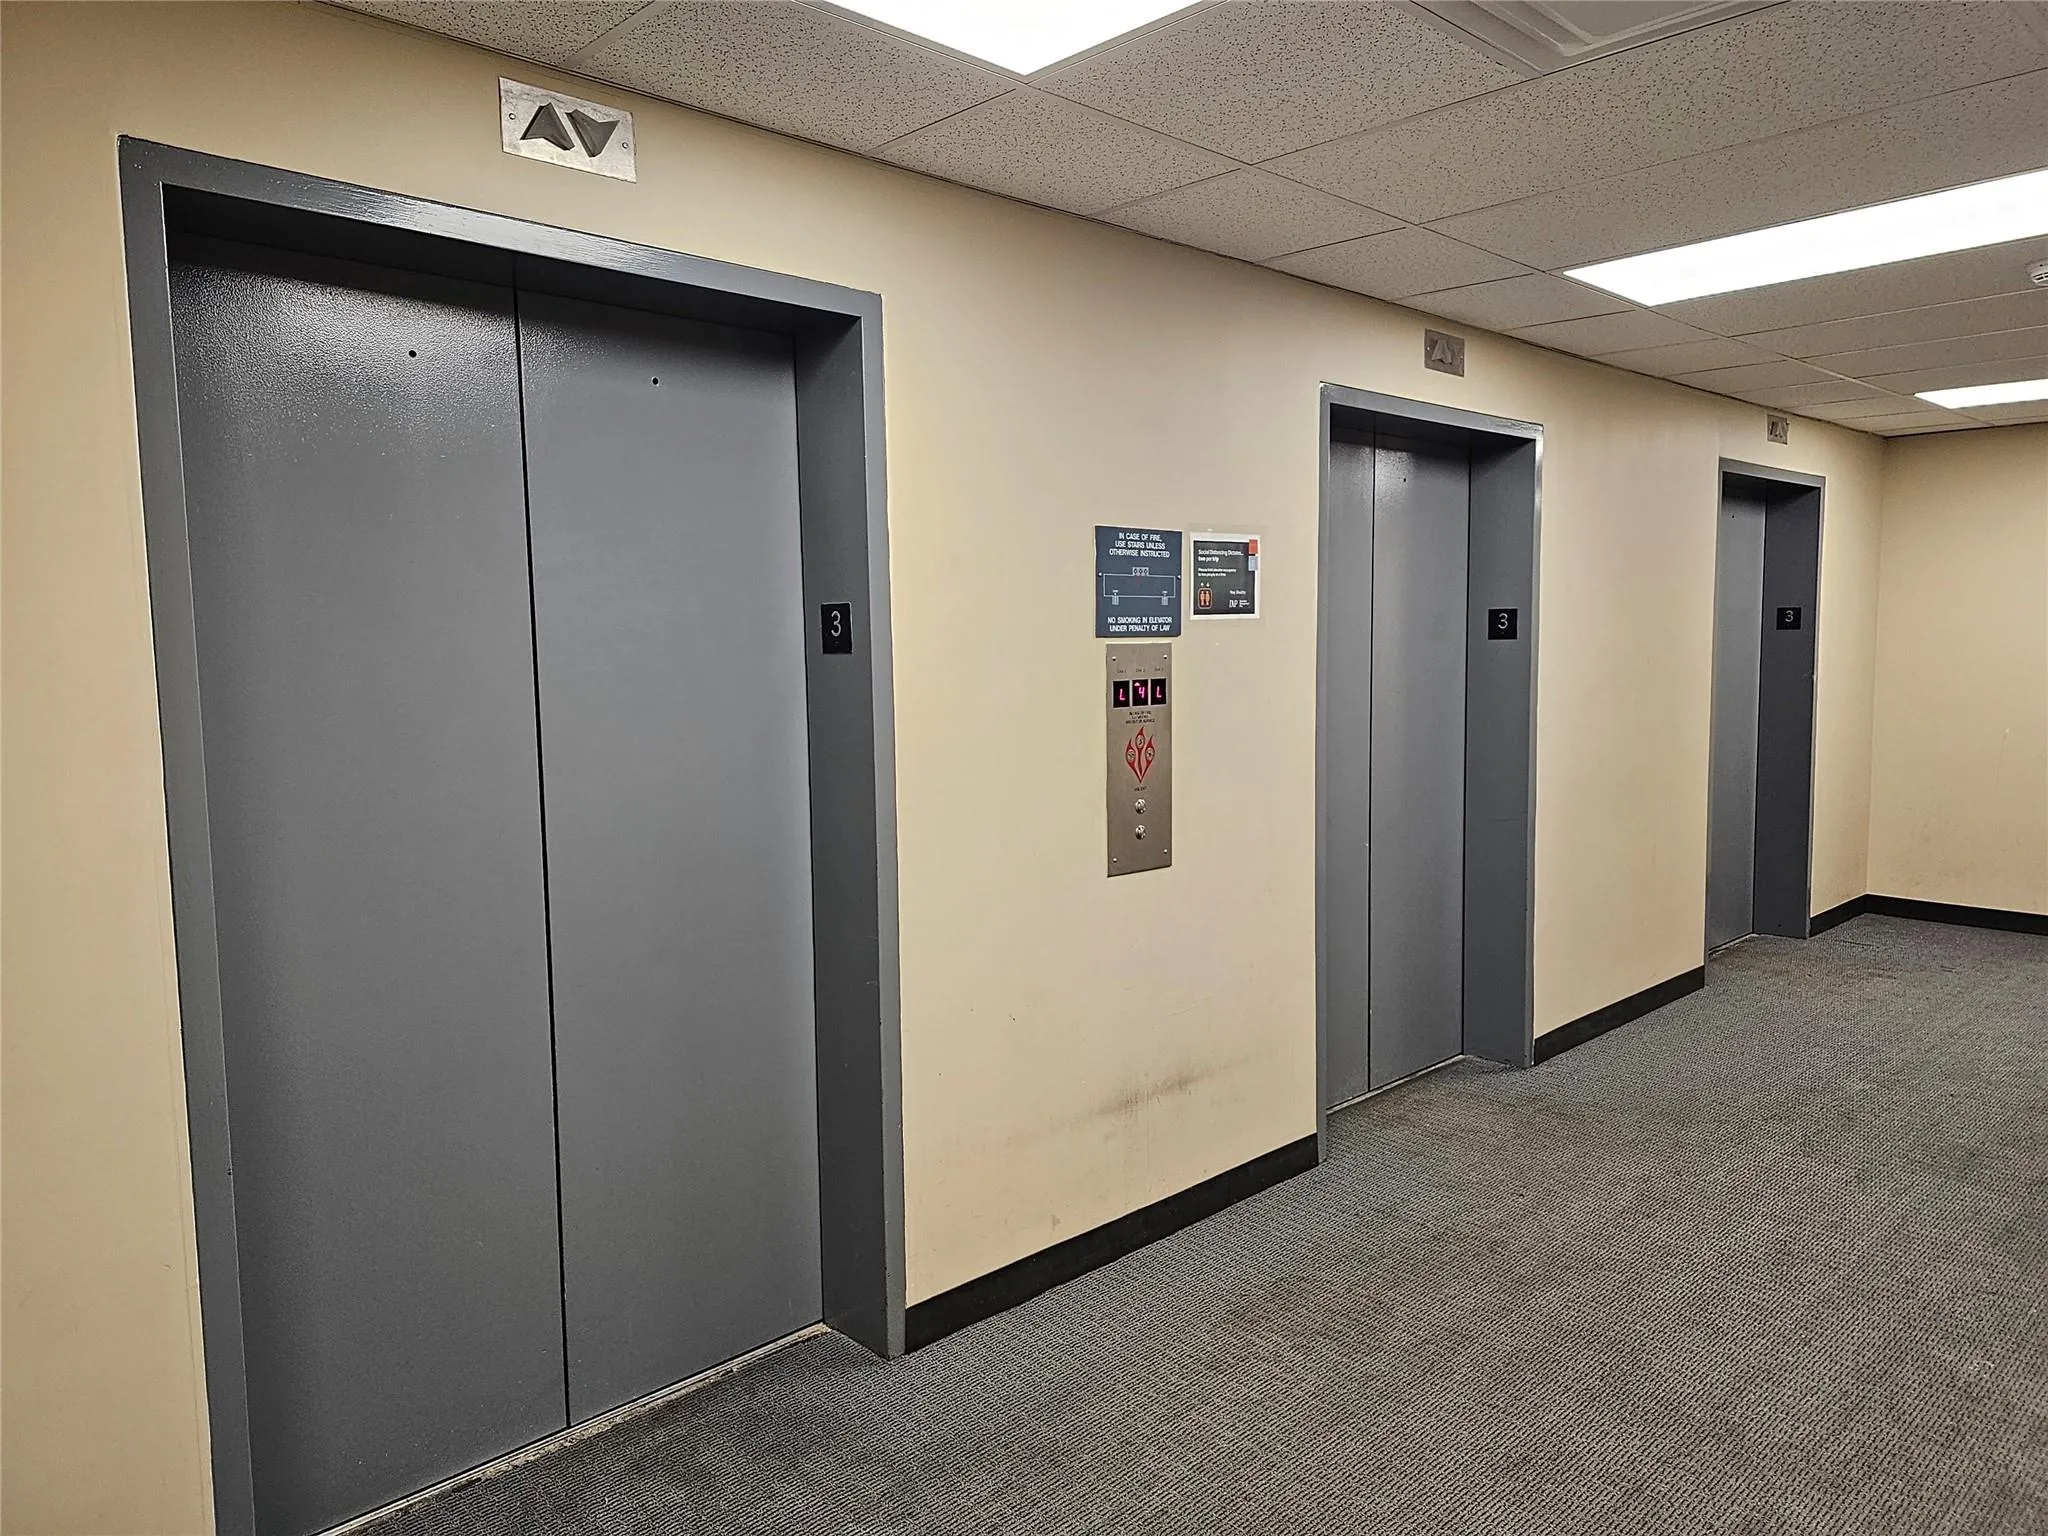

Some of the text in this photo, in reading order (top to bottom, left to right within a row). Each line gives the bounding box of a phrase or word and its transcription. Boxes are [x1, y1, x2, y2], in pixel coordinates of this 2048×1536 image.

[1141, 533, 1149, 541] OF
[1115, 540, 1126, 548] USE
[1127, 541, 1145, 549] STAIRS
[1109, 548, 1170, 558] OTHERWISE INSTRUCTED
[1107, 616, 1173, 624] NO SMOKING IN ELEVATOR
[1498, 613, 1508, 629] 3
[1785, 610, 1794, 622] 3
[831, 610, 842, 637] 3
[1109, 624, 1128, 632] UNDER
[1119, 688, 1126, 701] L
[1139, 686, 1145, 699] 4
[1156, 685, 1162, 698] L
